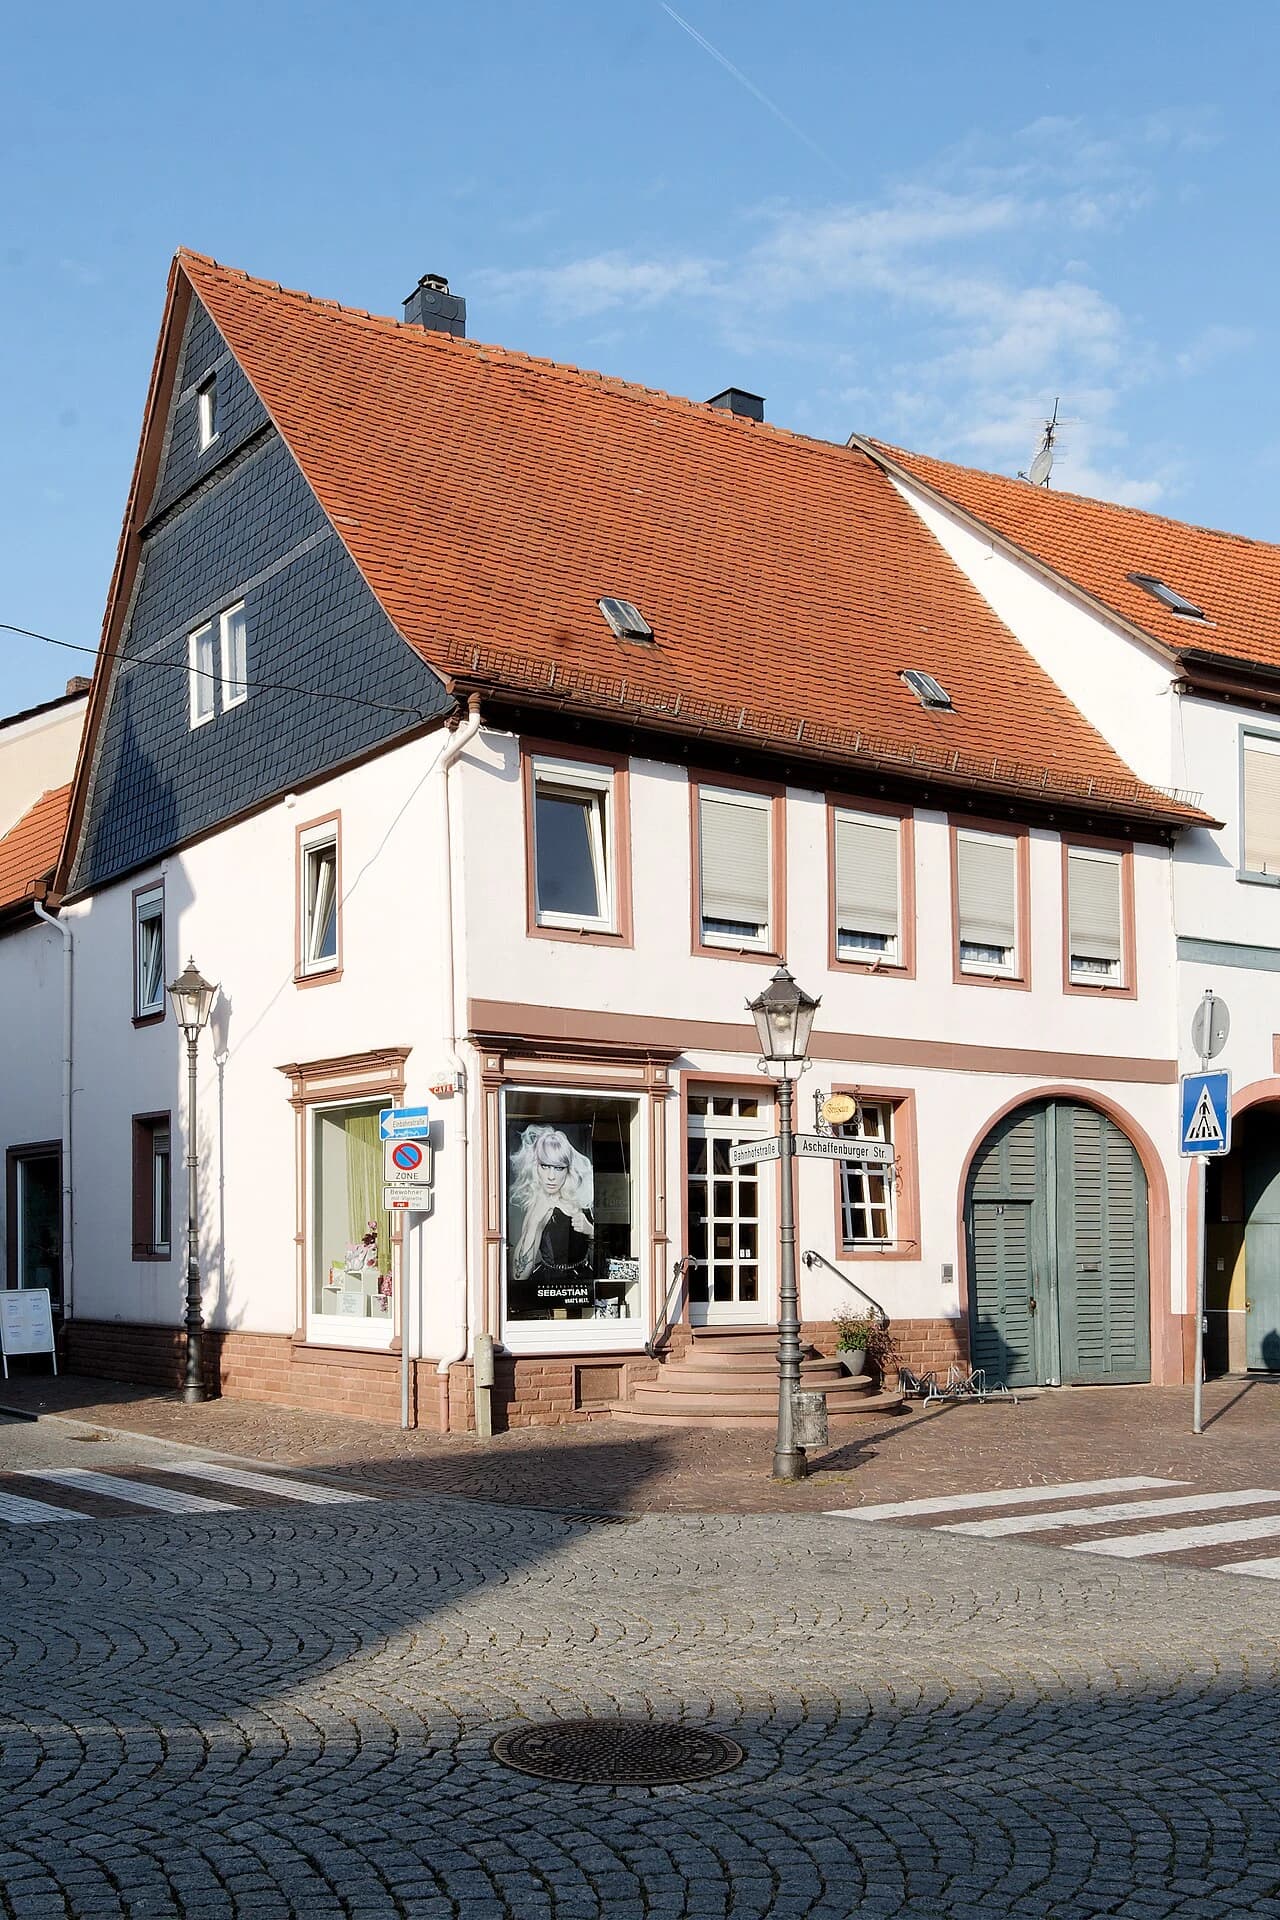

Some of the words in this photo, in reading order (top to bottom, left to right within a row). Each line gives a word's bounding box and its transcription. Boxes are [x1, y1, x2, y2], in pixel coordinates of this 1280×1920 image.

[733, 1143, 776, 1162] Bahnhofstraße
[802, 1139, 869, 1159] Aschaffenburger
[873, 1147, 887, 1159] Str.
[395, 1172, 420, 1180] ZONE
[537, 1288, 588, 1297] SEBASTIAN
